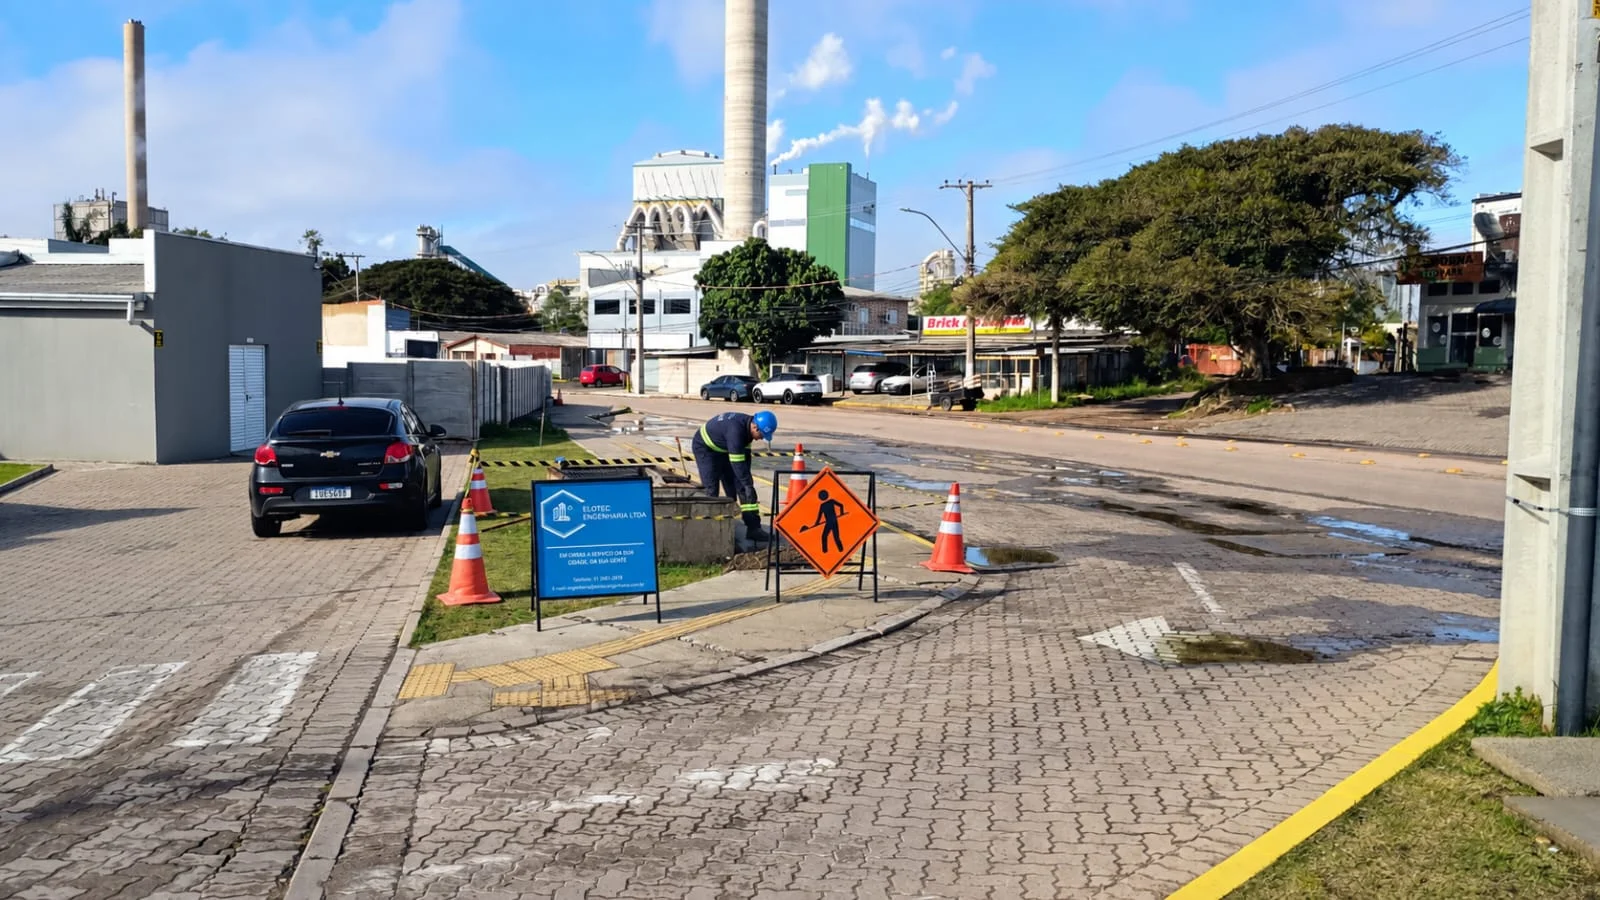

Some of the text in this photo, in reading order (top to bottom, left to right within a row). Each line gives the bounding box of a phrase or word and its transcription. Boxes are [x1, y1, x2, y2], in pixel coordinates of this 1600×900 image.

[927, 317, 959, 329] Brick
[583, 511, 647, 520] ENGENHARIA LTDA
